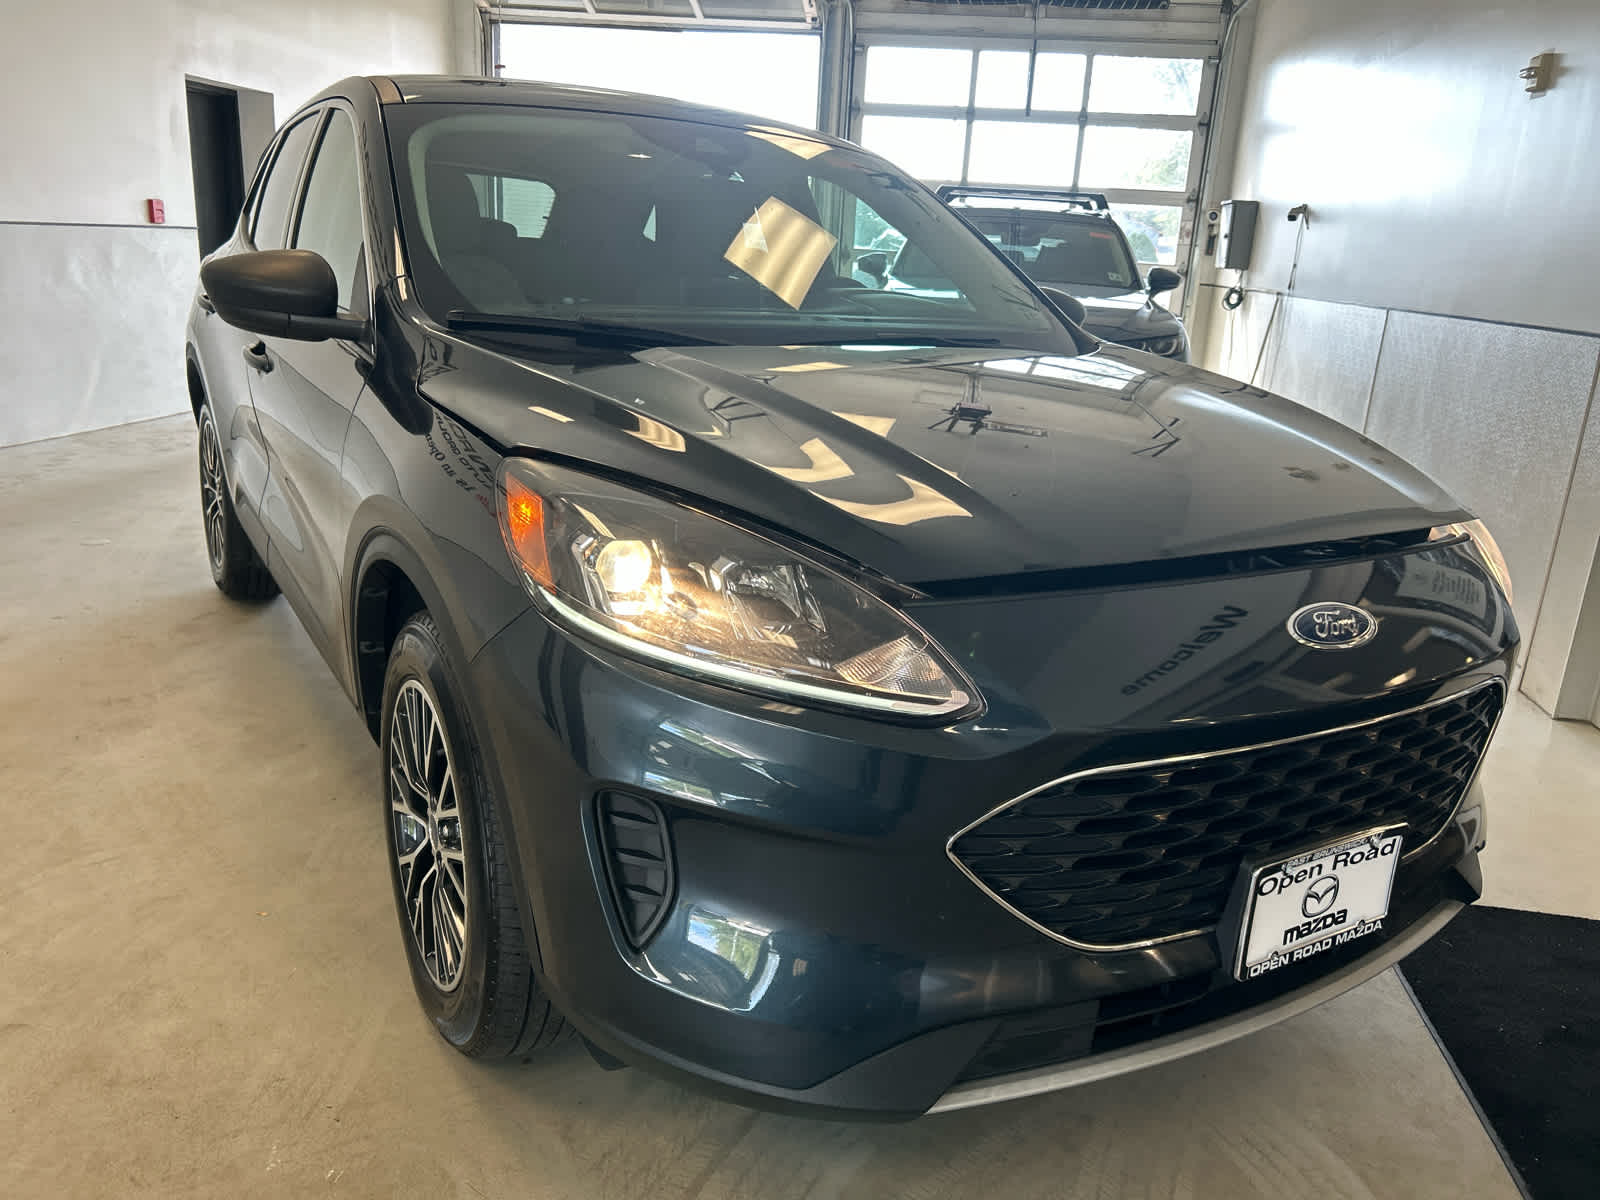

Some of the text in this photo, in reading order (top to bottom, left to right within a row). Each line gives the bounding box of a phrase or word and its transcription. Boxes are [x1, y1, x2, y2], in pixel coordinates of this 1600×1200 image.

[1313, 610, 1360, 638] Ford
[1259, 863, 1323, 897] Open
[1332, 838, 1397, 871] Road
[1250, 919, 1383, 977] OPEN ROAD MAZDA
[1282, 908, 1348, 946] mazda
